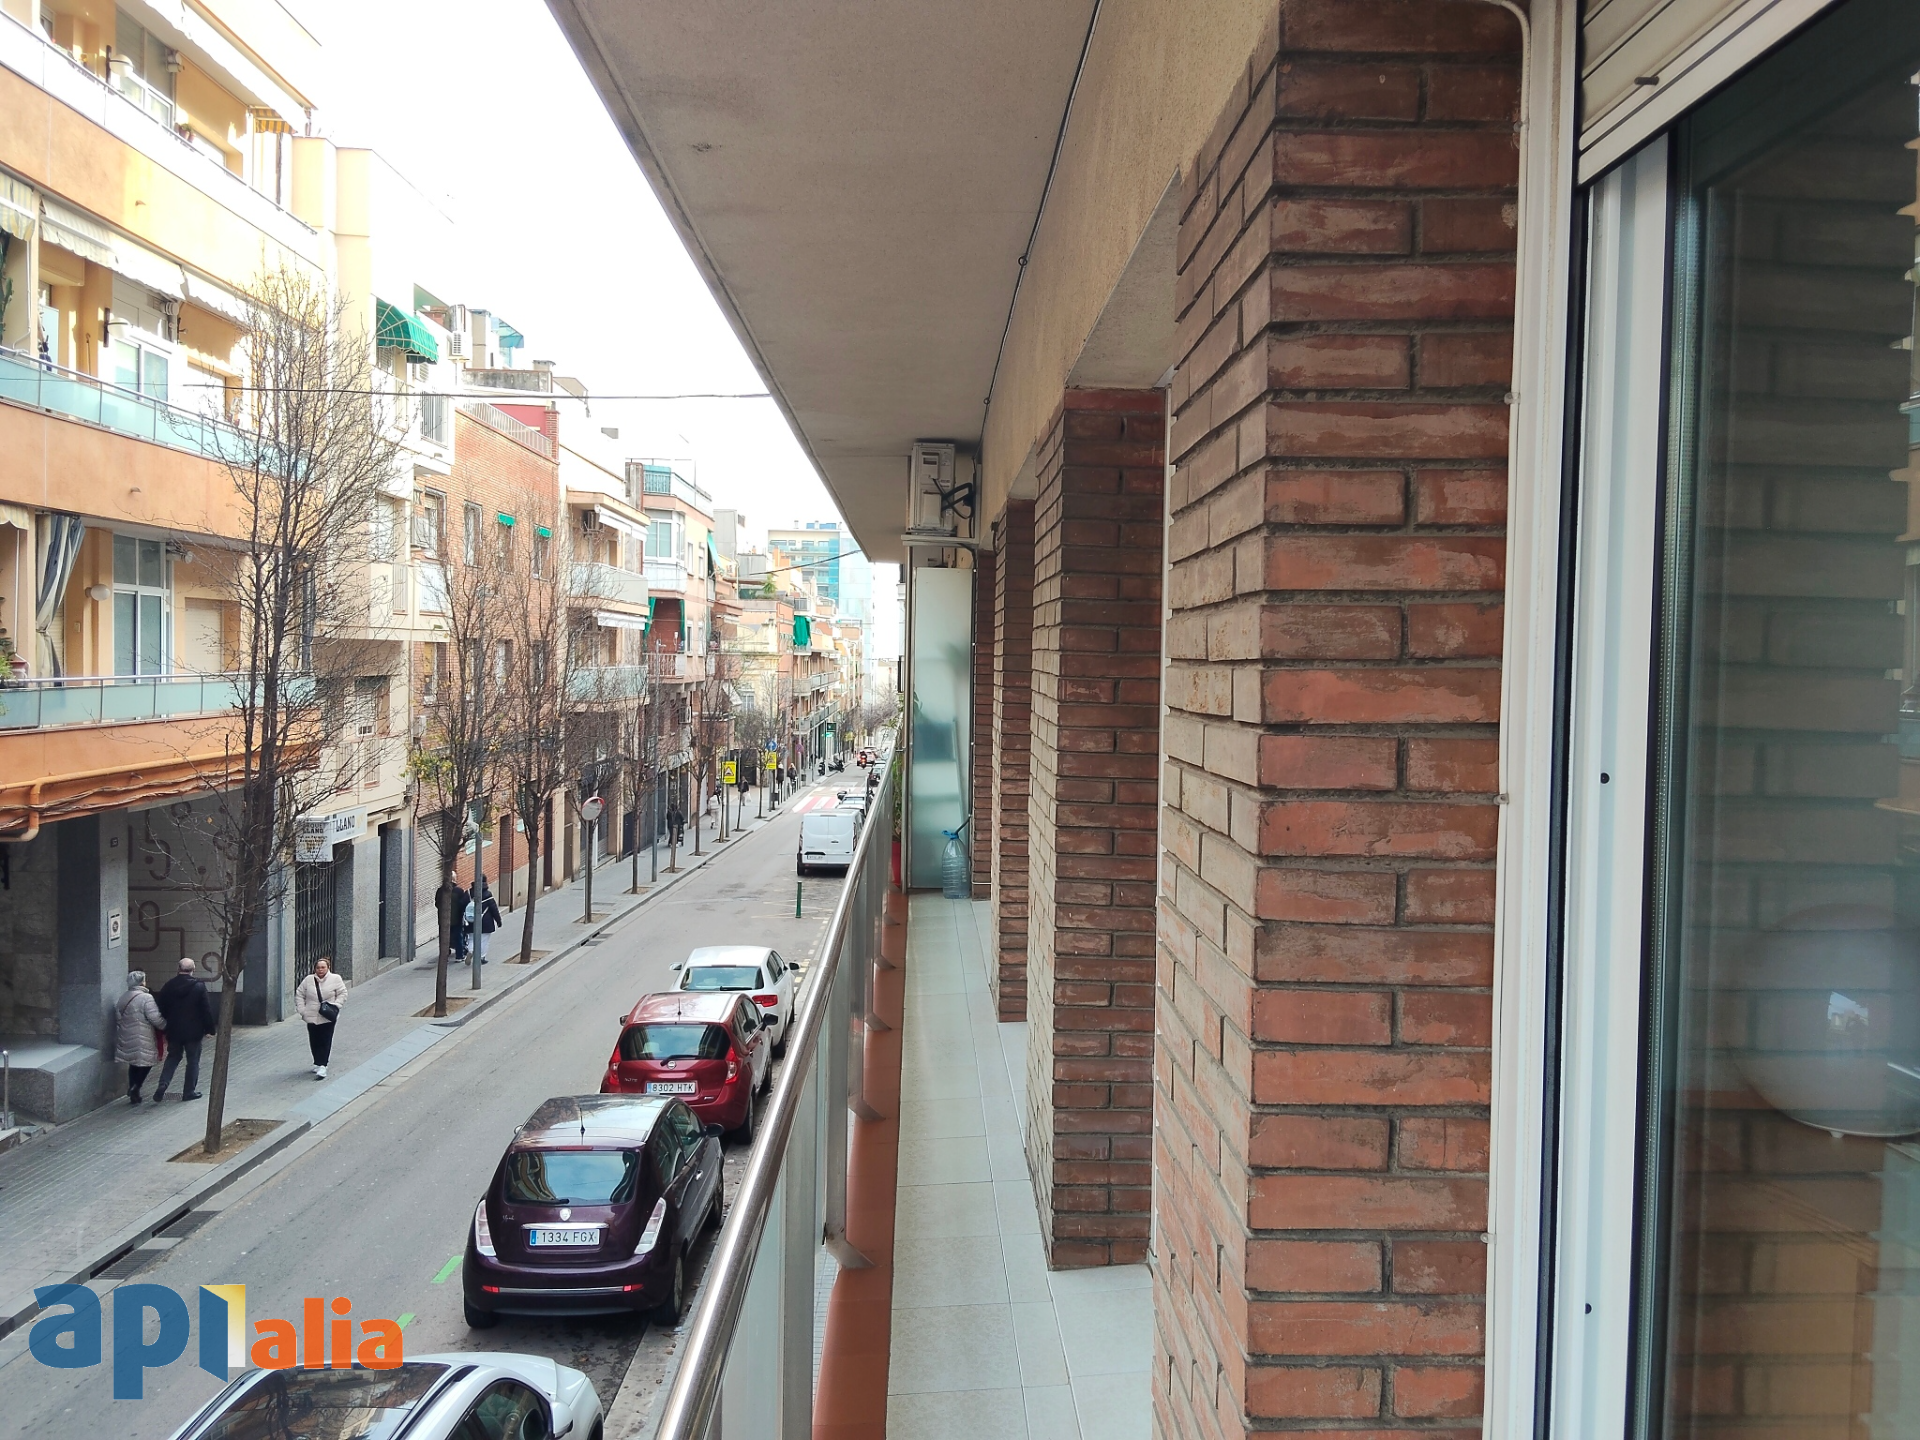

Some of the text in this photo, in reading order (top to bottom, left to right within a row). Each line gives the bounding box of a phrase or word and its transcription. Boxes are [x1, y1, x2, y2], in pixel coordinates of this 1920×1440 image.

[652, 1083, 694, 1092] 8302 HTK
[542, 1231, 595, 1243] 1334 FGX
